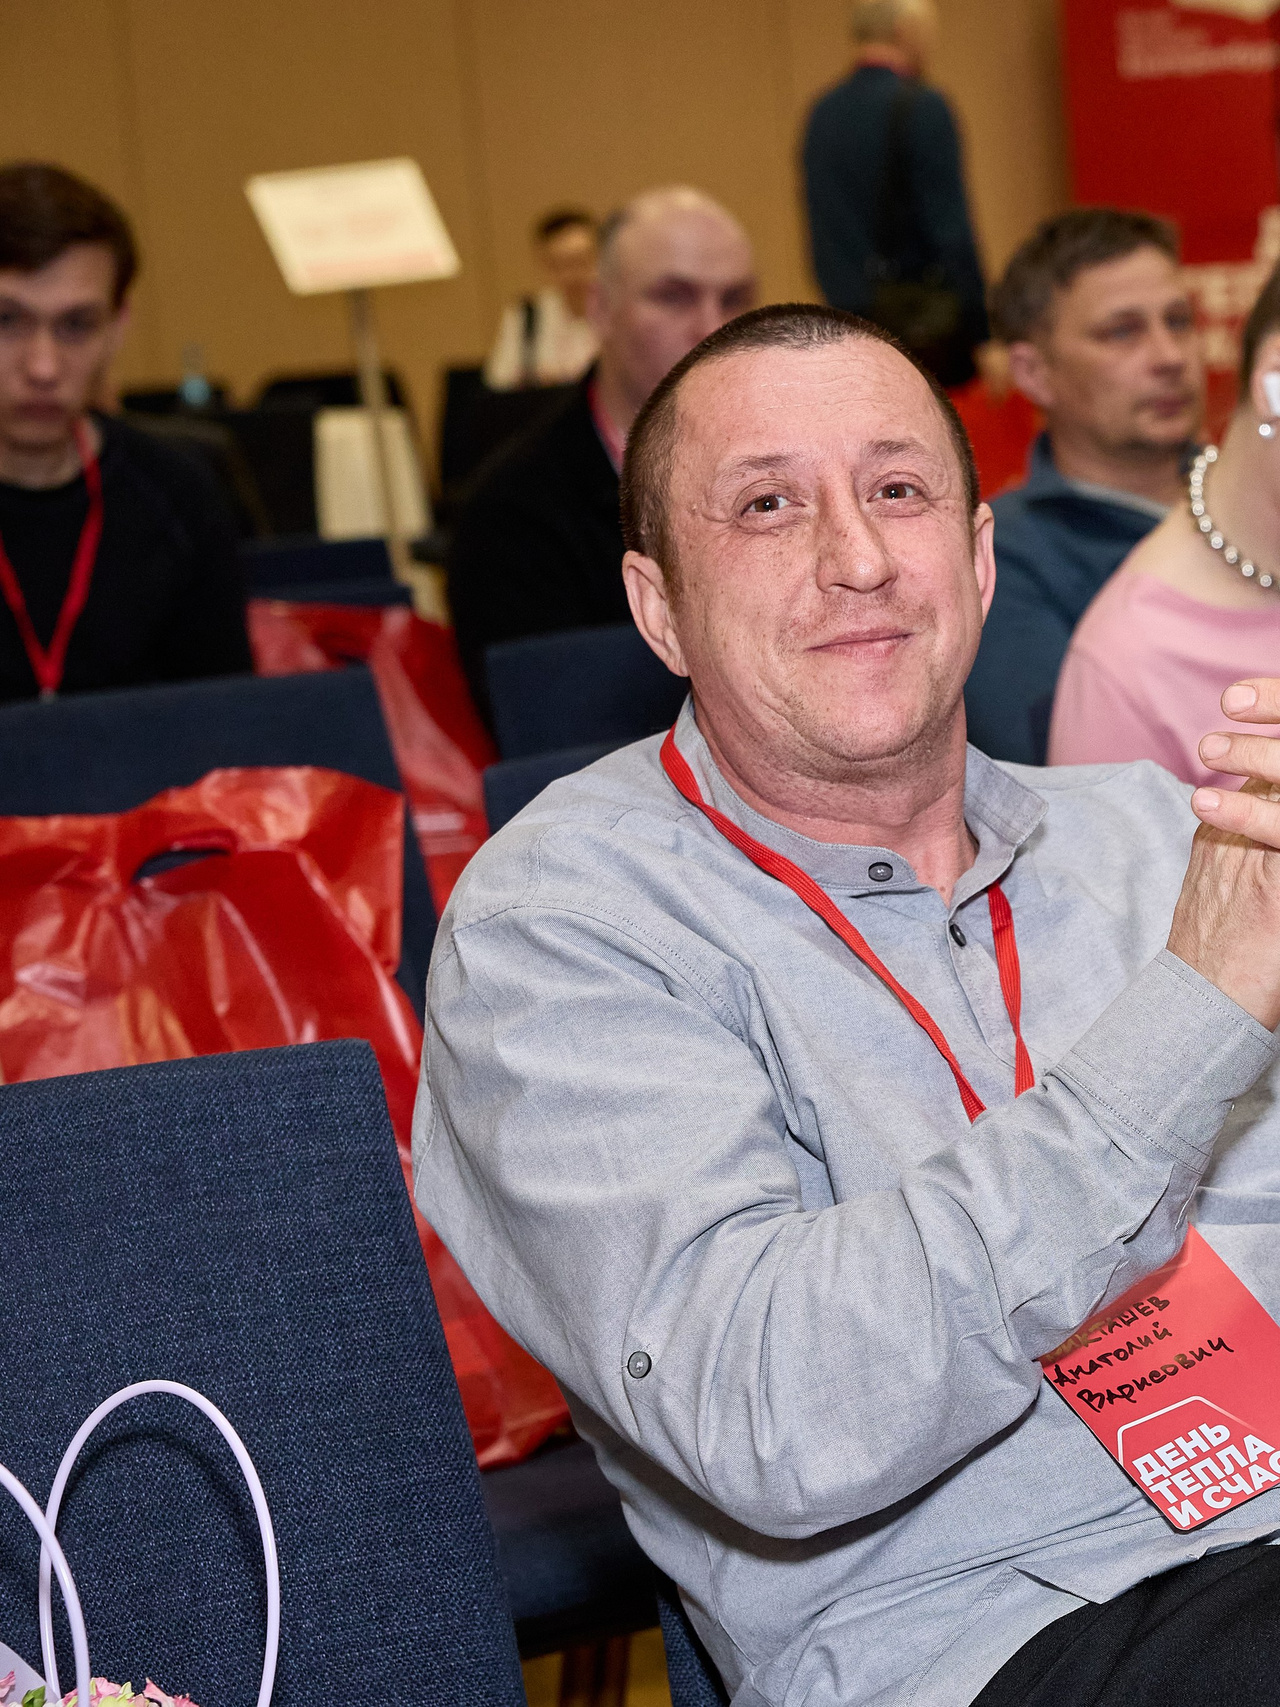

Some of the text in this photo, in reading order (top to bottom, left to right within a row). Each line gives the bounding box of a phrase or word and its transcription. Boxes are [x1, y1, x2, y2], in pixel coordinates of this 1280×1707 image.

[1132, 1422, 1231, 1487] ДЕНЬ
[1149, 1433, 1276, 1504] ТЕПЛА
[1167, 1499, 1203, 1528] И
